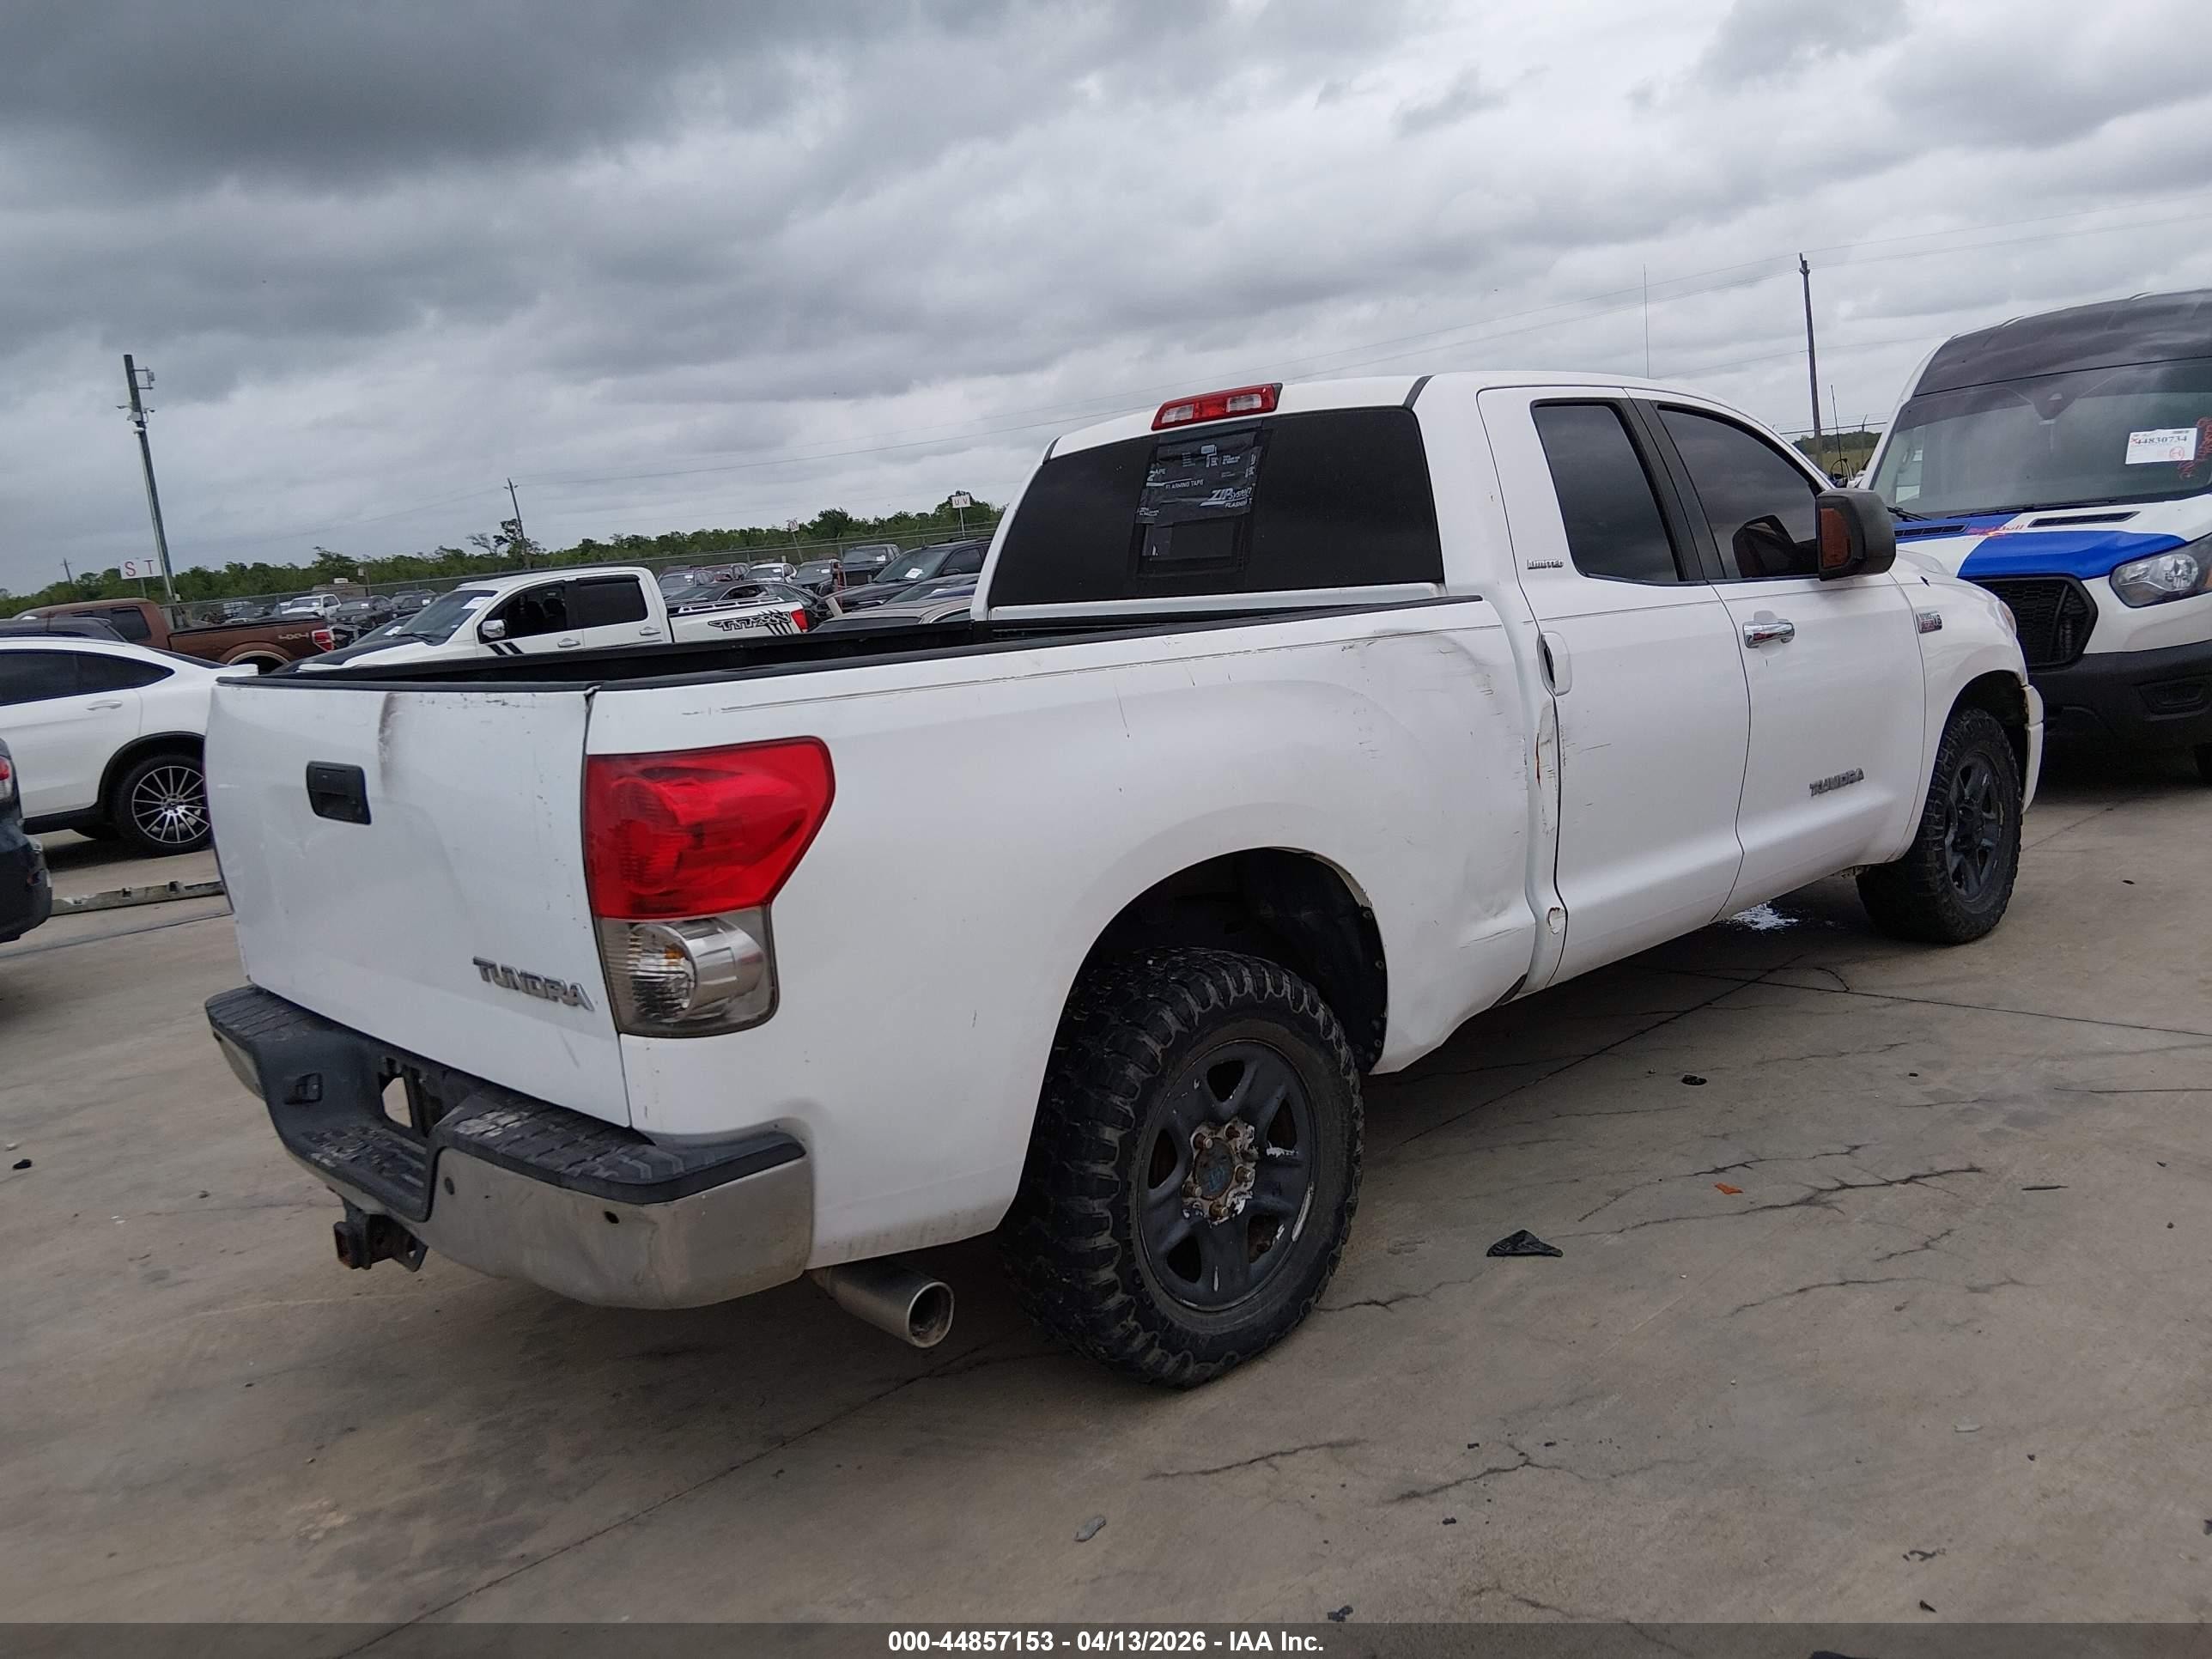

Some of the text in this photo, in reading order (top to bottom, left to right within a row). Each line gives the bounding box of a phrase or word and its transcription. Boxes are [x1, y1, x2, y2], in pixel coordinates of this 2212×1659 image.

[124, 559, 154, 577] S T
[1809, 768, 1864, 797] TUNDRA
[472, 956, 595, 1012] TUNDRA
